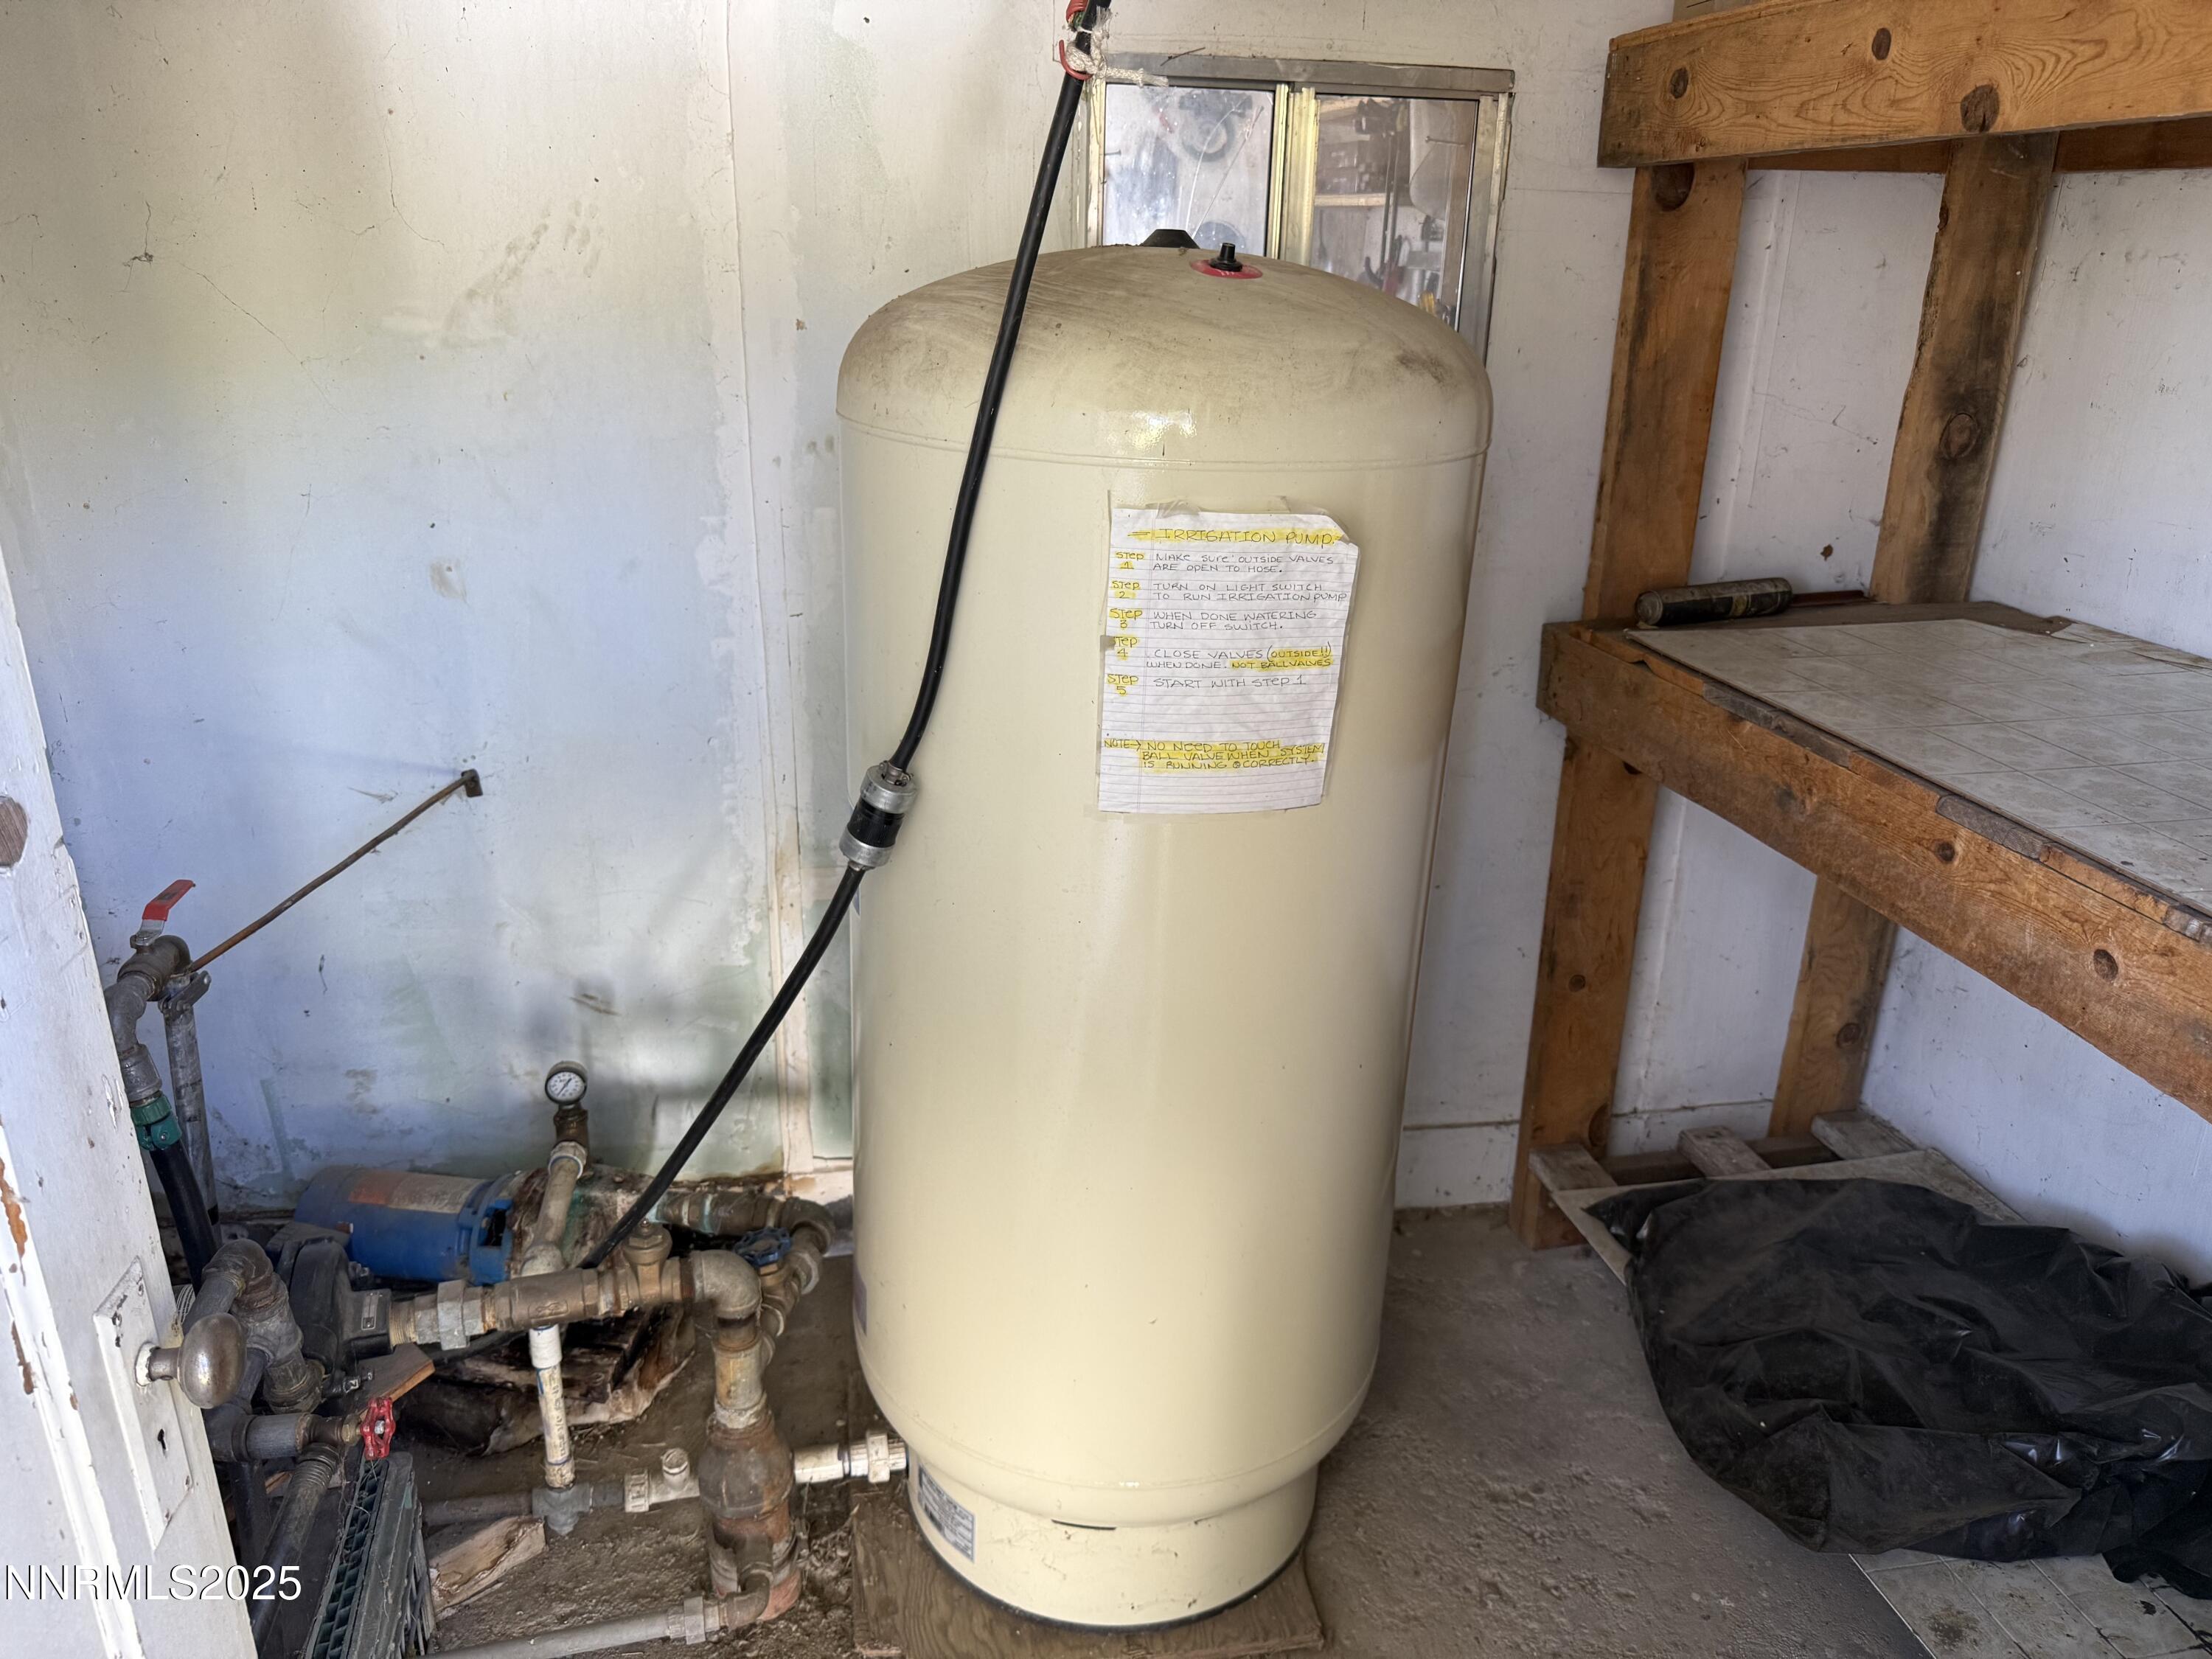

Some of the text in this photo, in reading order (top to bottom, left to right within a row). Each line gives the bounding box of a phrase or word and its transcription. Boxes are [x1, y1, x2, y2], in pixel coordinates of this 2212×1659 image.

[1155, 528, 1276, 543] IRRIGATION
[1289, 555, 1334, 564] VALVES
[1248, 565, 1282, 573] HOSE.
[1153, 592, 1169, 600] TO
[1183, 592, 1211, 600] RUN
[1217, 593, 1310, 601] IRRIGATION
[1153, 611, 1317, 621] WHEN DONE WATERING
[1119, 619, 1127, 628] 3
[1150, 622, 1183, 630] TURN
[1191, 622, 1217, 630] OFF
[1116, 647, 1129, 657] 4
[1154, 649, 1201, 659] CLOSE
[1208, 649, 1263, 659] VALVES
[1153, 678, 1203, 688] START
[1211, 678, 1245, 688] WITH
[1293, 675, 1307, 685] 1
[1116, 686, 1127, 695] 5
[1147, 742, 1165, 751] NO
[1220, 742, 1237, 751] TO
[1243, 740, 1281, 751] TOUCH
[1143, 742, 1325, 761] BALL VALVE WHEN SYSTEM
[1166, 761, 1228, 769] RUNNING
